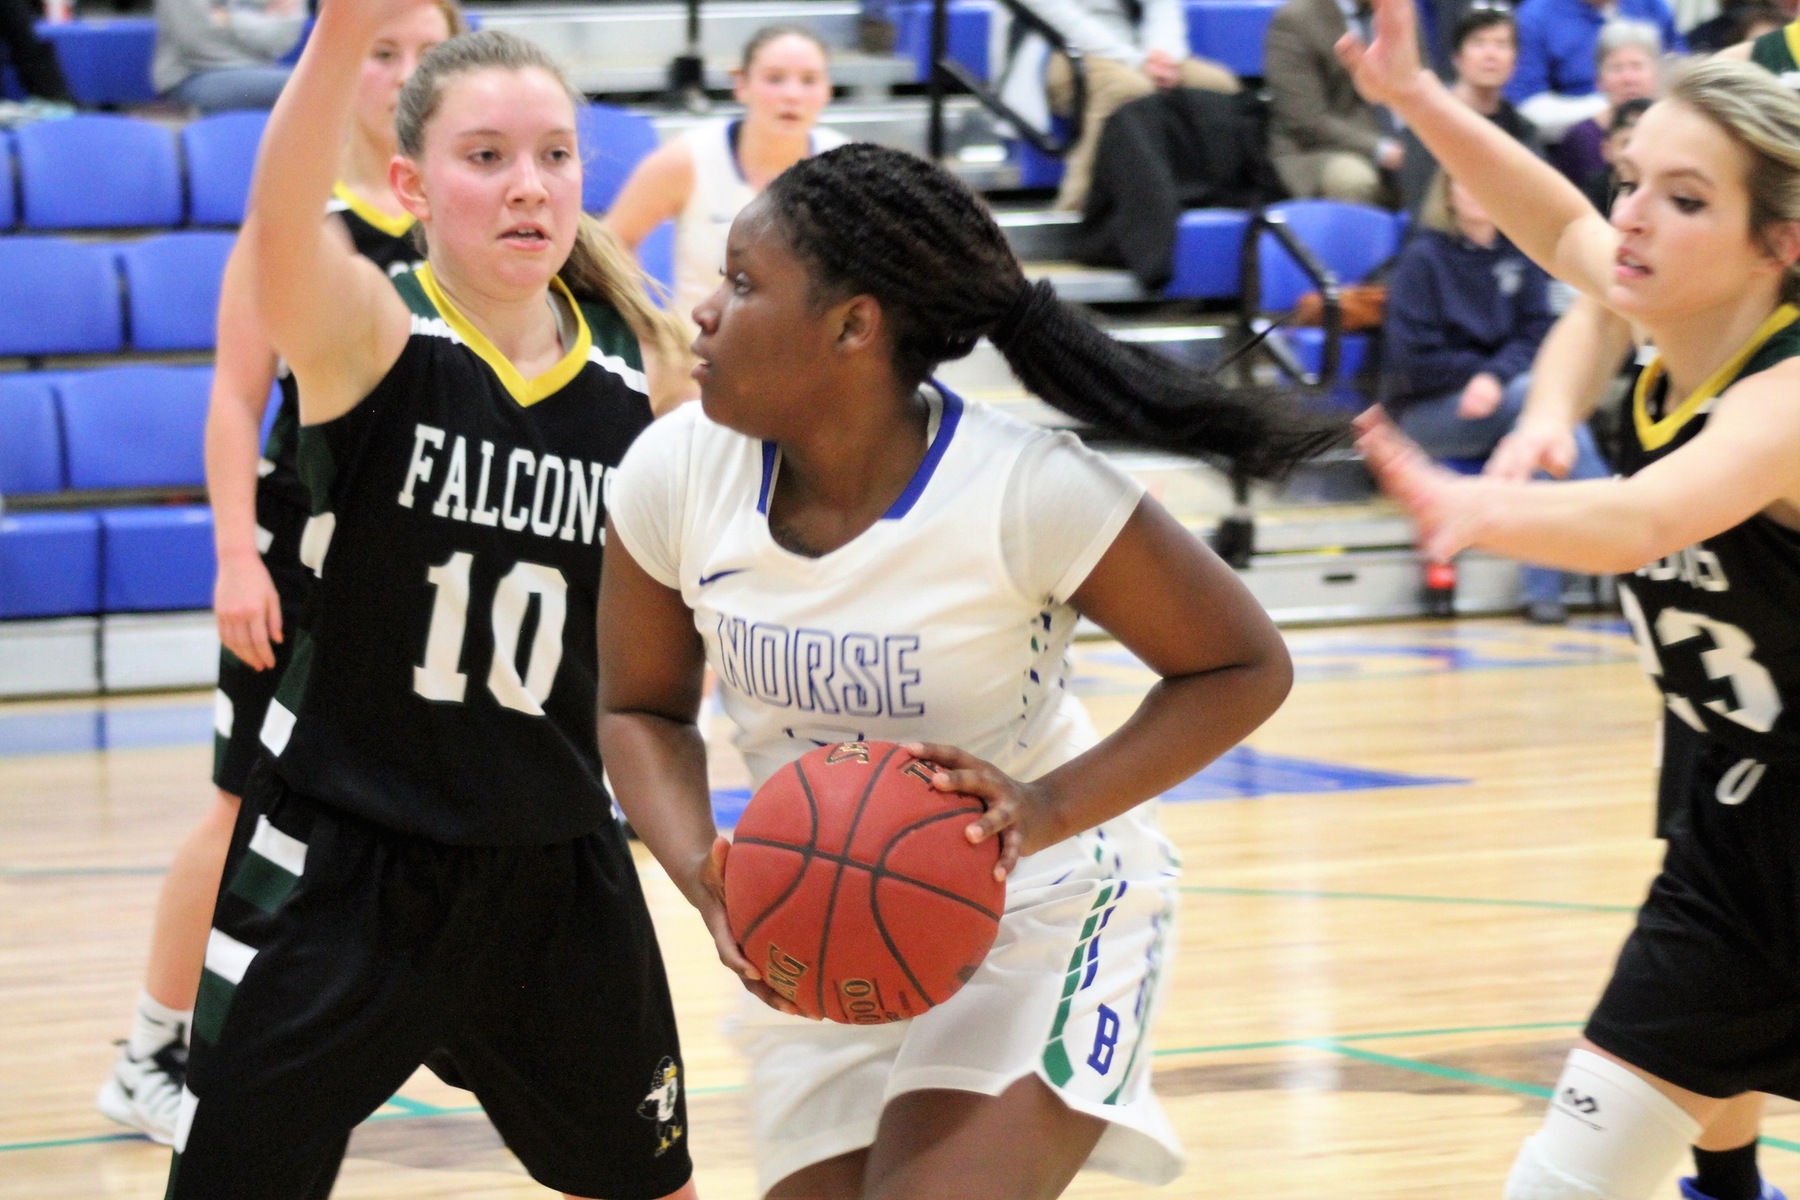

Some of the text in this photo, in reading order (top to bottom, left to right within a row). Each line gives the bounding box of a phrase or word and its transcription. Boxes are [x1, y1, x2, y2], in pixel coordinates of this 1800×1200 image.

[413, 551, 567, 716] 10
[717, 611, 925, 719] NORSE
[1086, 1002, 1120, 1076] B
